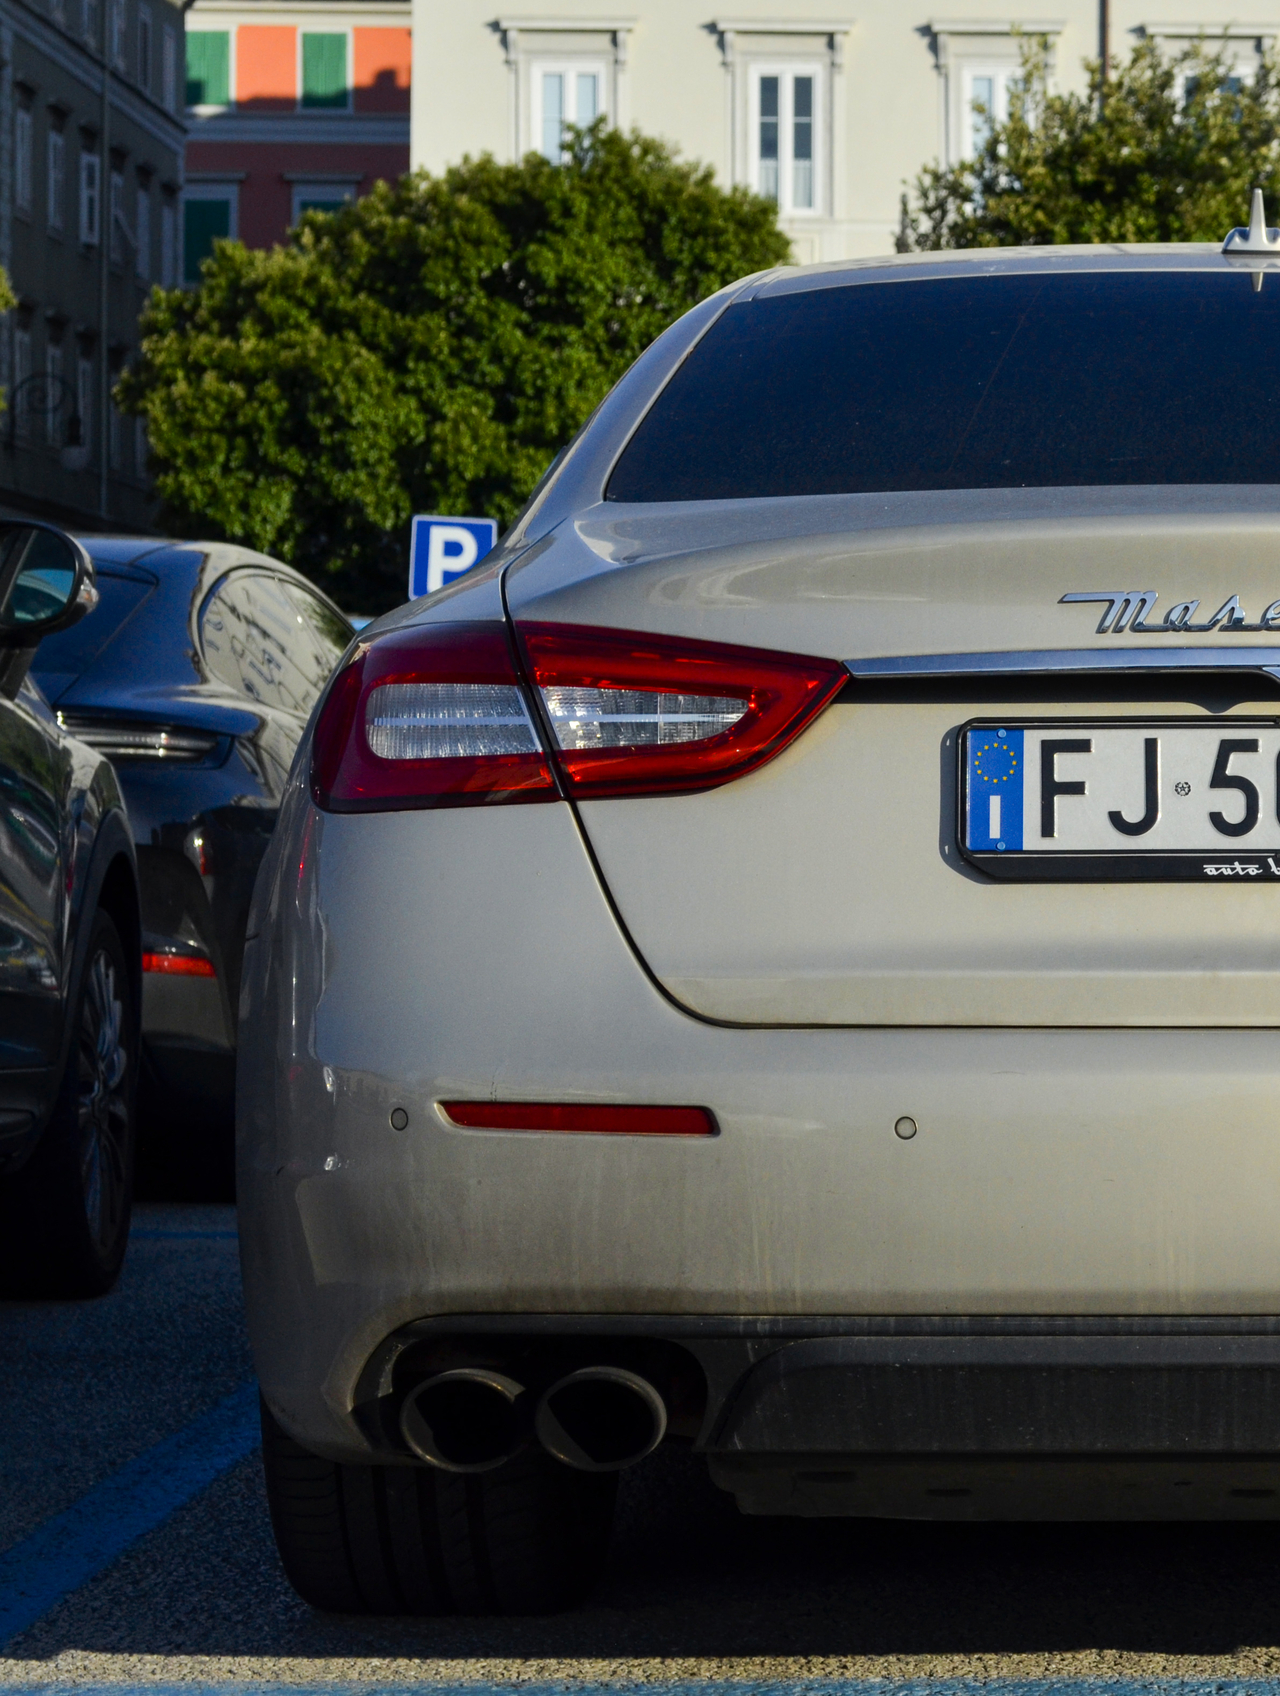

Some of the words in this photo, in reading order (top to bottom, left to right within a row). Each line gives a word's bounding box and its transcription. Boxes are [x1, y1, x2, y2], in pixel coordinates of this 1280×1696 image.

[427, 524, 478, 594] P
[1040, 737, 1162, 838] FJ
[1203, 861, 1263, 876] auto
